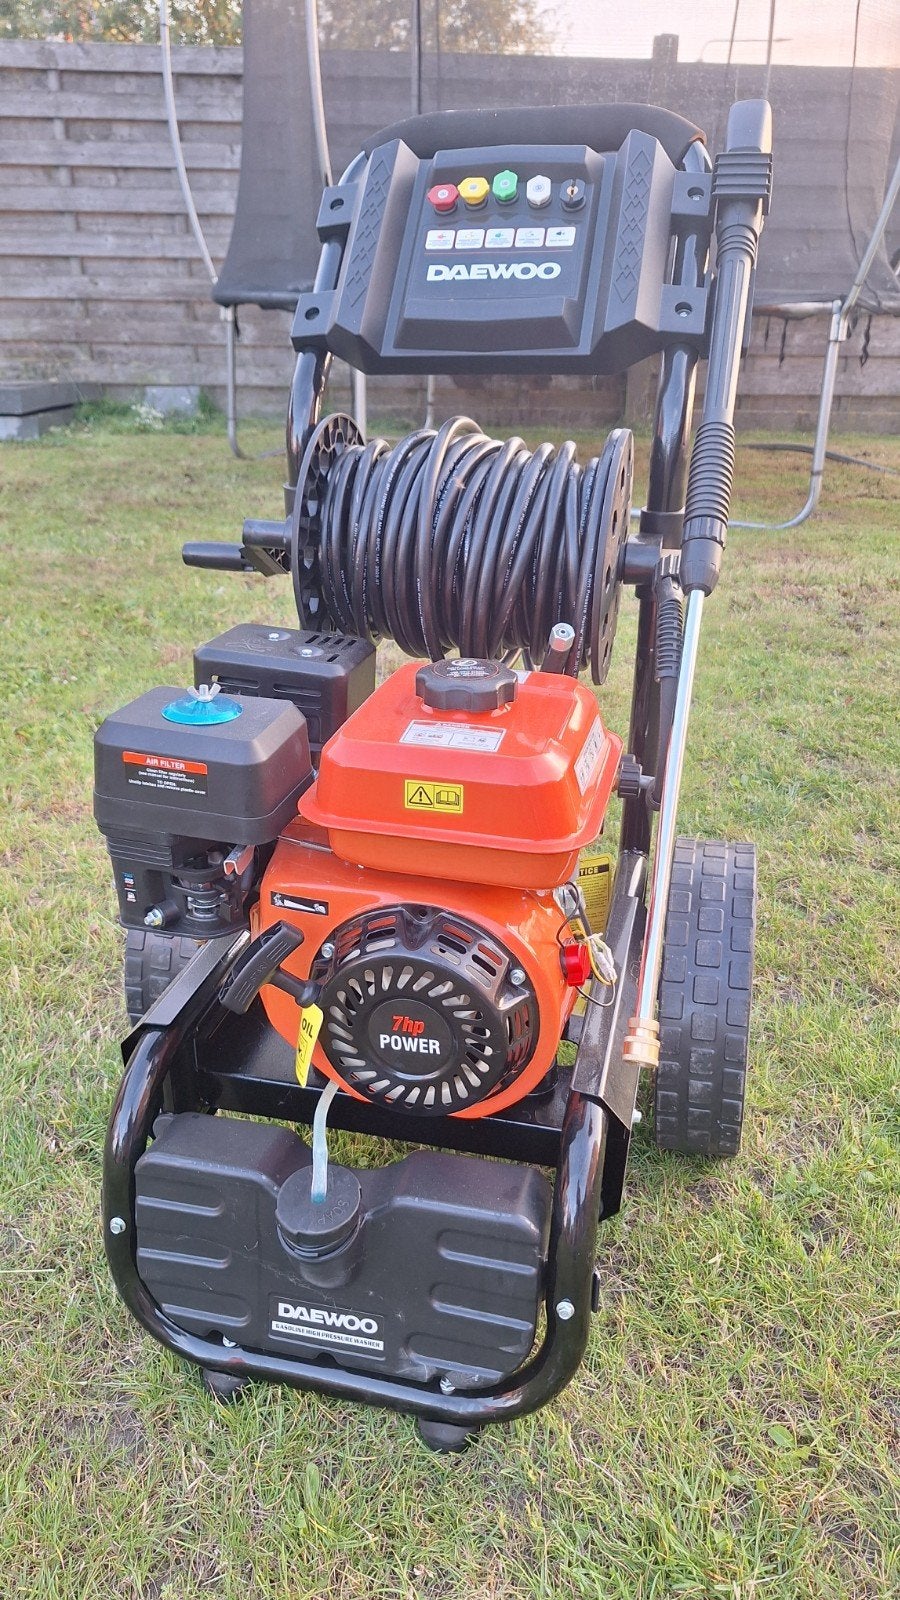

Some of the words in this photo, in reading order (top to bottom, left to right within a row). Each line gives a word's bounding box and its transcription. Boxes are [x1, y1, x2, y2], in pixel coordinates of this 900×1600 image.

[426, 262, 562, 282] DAEWOO
[146, 757, 158, 766] AIR
[160, 760, 186, 770] FILTER
[580, 866, 599, 876] TICE
[301, 1018, 313, 1039] OIL
[392, 1015, 425, 1036] 7hp
[379, 1034, 441, 1055] POWER
[317, 1199, 349, 1224] SOAP
[278, 1302, 378, 1334] DAEWOO
[275, 1323, 305, 1334] GASOLINE
[305, 1328, 321, 1337] HIGH
[321, 1331, 353, 1343] PRESSURE
[354, 1337, 380, 1348] WASHER
